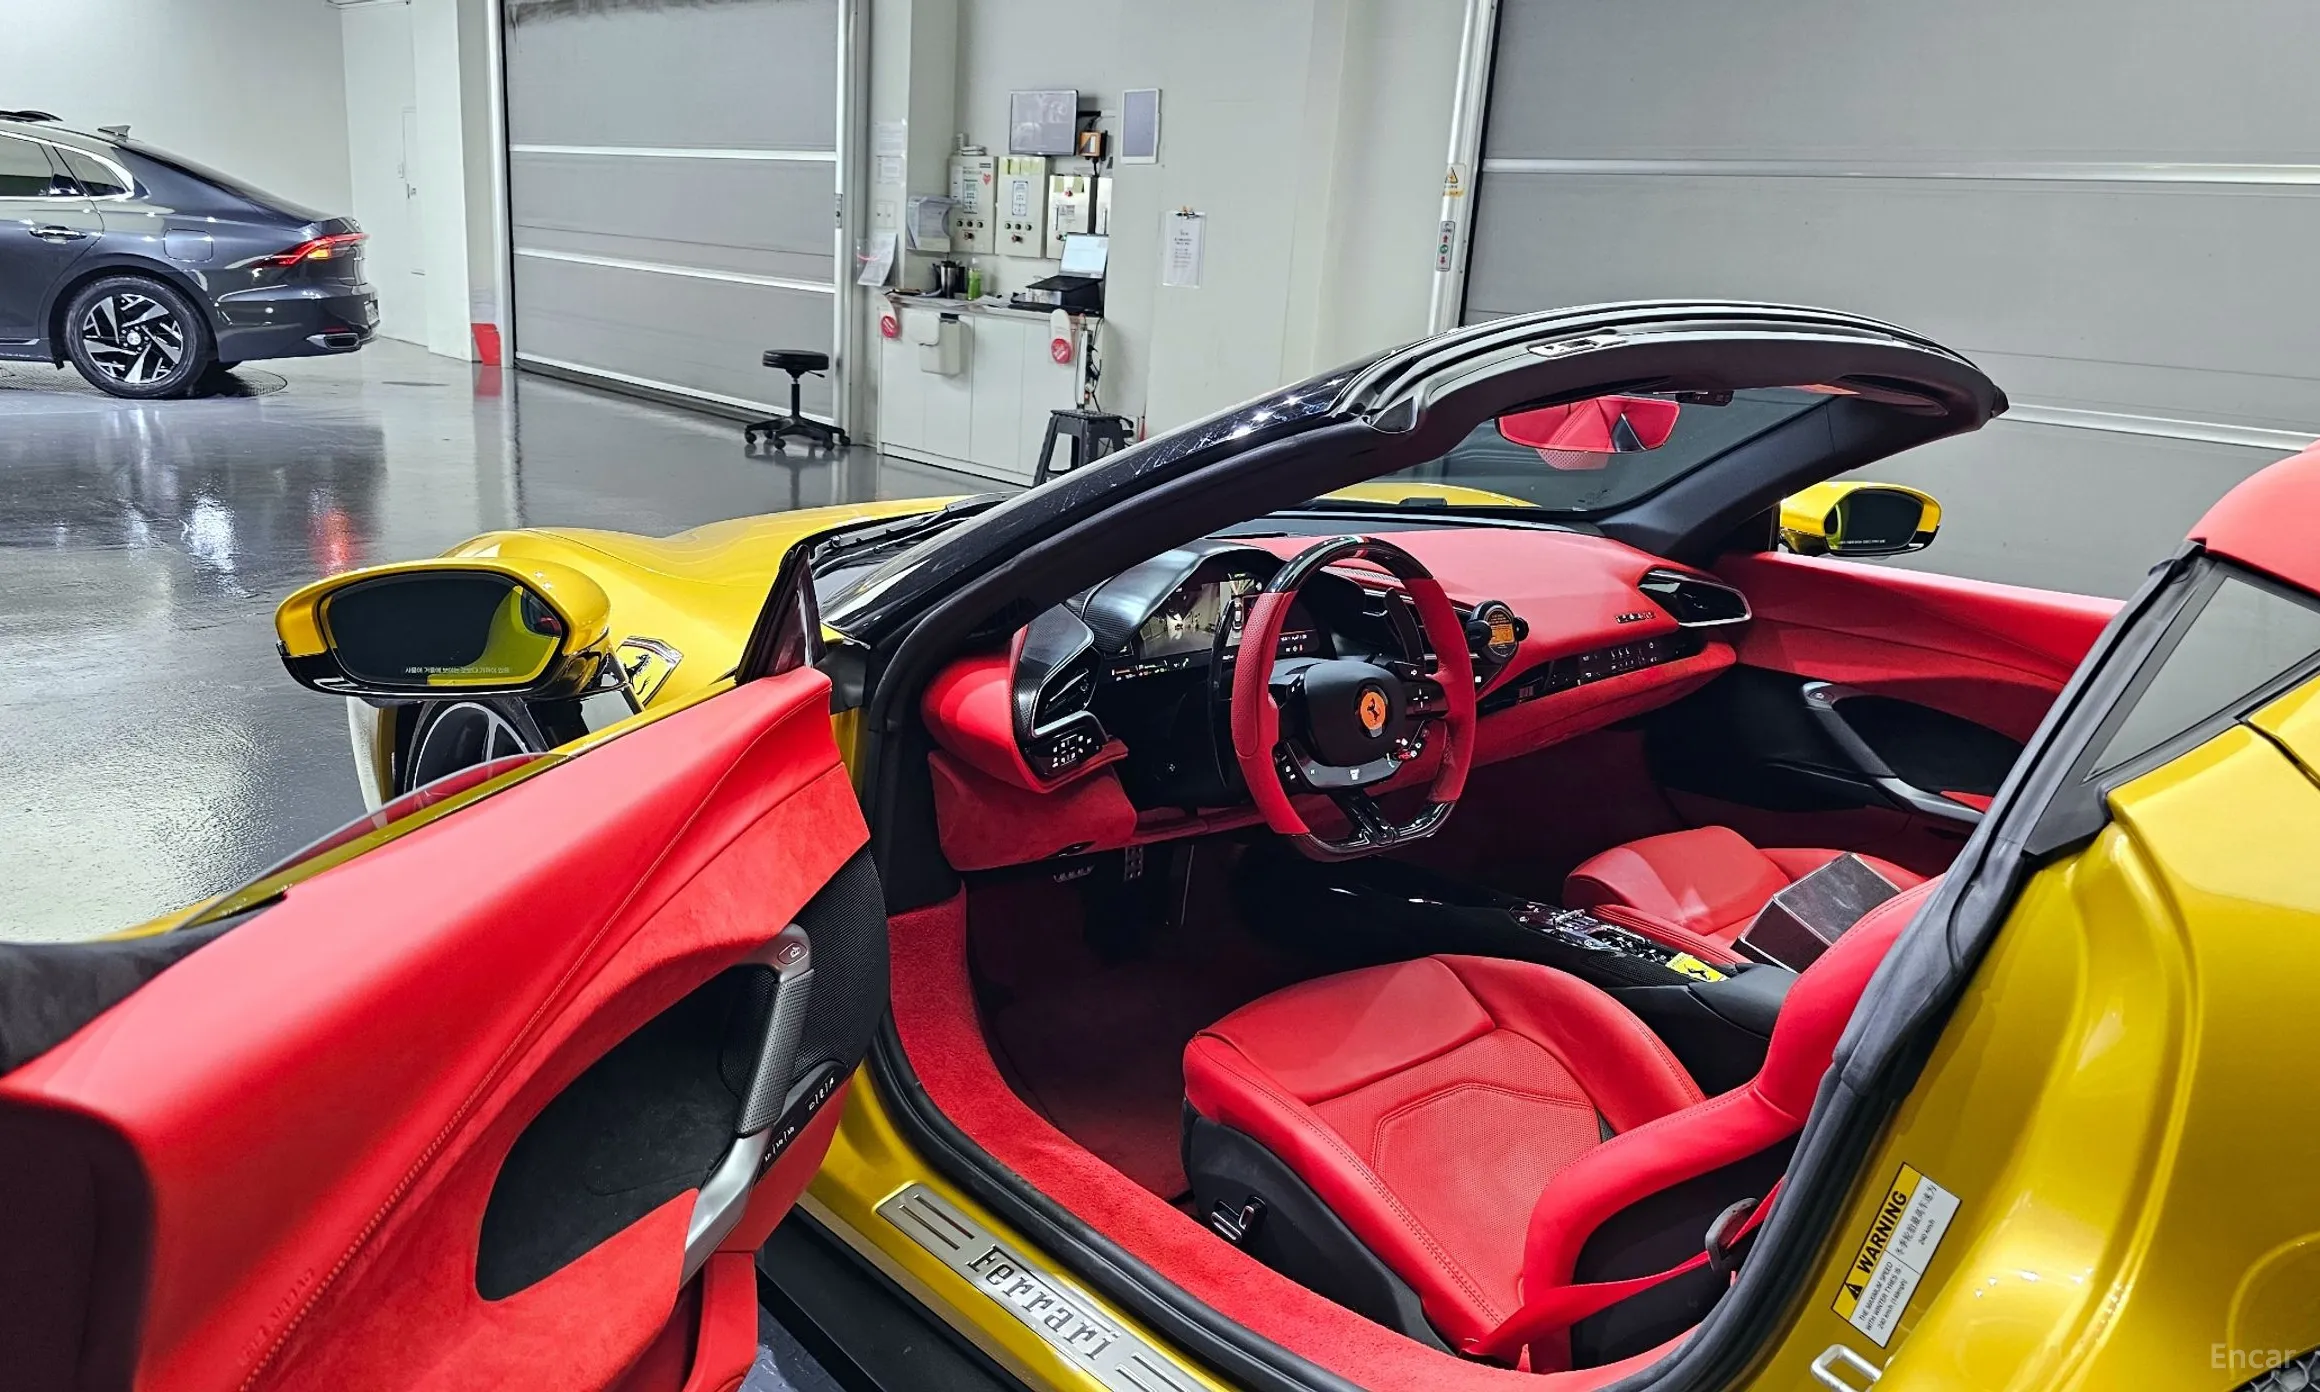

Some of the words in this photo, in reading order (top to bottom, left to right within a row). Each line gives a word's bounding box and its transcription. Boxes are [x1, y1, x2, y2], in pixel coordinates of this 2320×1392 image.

[1855, 1189, 1908, 1274] WARNING
[1878, 1260, 1893, 1282] SPEED
[965, 1243, 1121, 1360] Ferrari
[1858, 1308, 1869, 1321] THE
[1863, 1280, 1883, 1309] MAXIMUM
[1865, 1314, 1876, 1331] WITH
[1872, 1292, 1888, 1316] WINTER
[1884, 1273, 1898, 1293] TYRES
